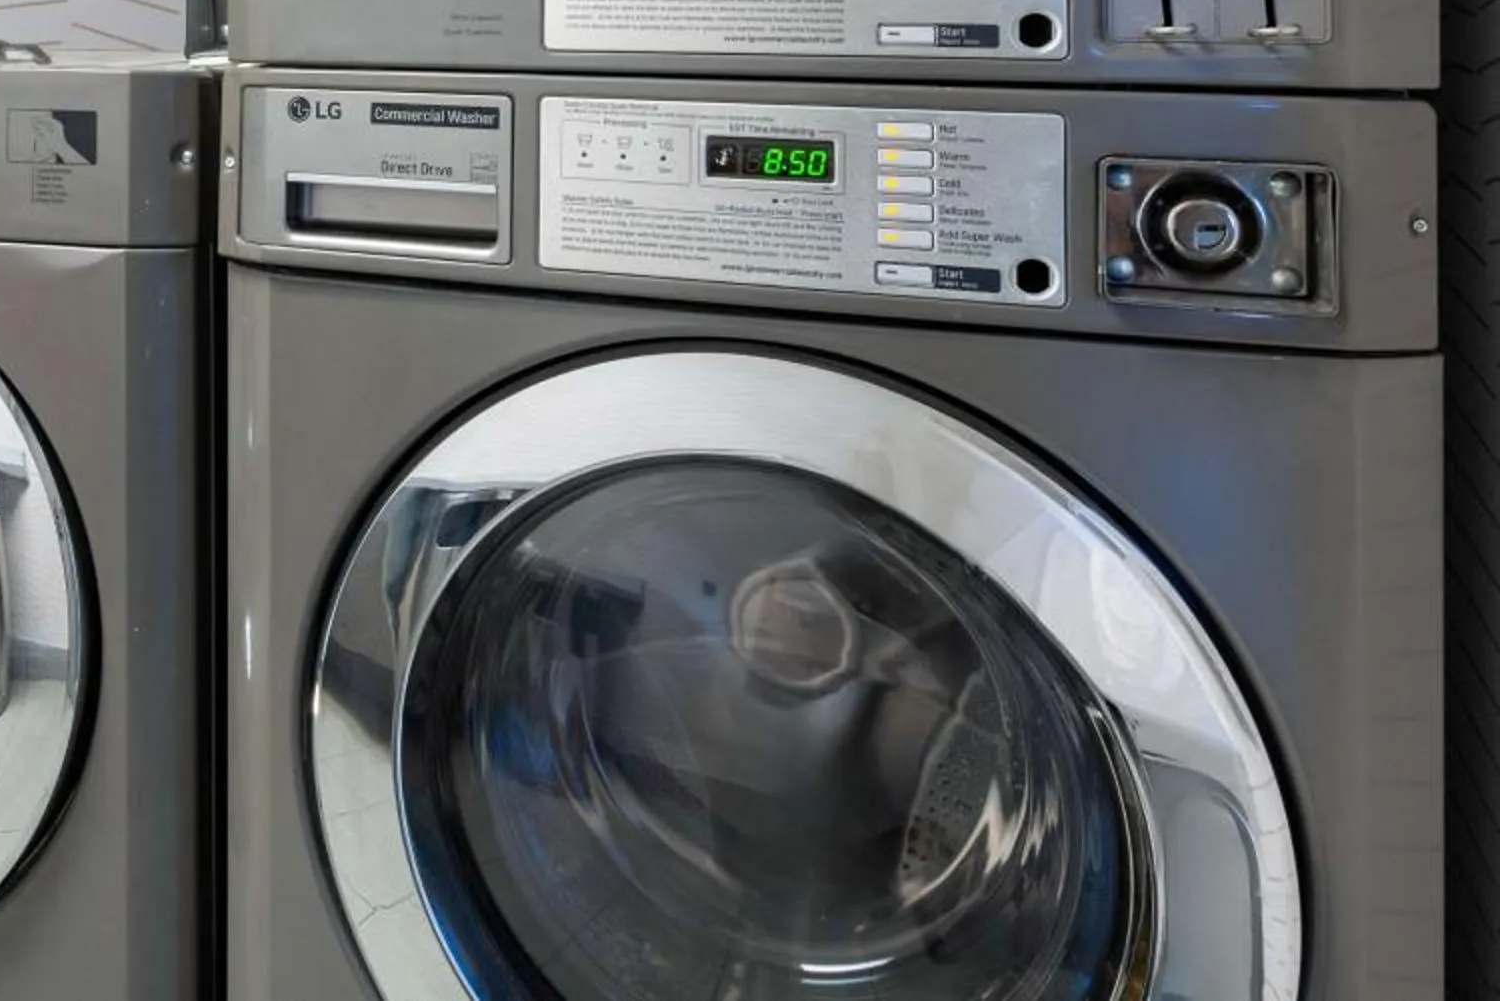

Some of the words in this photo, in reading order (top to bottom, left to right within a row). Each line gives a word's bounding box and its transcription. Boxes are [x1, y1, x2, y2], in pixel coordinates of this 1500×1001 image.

[940, 26, 966, 37] Start
[374, 106, 445, 123] Commercial
[447, 109, 497, 126] Washer
[381, 160, 418, 175] Direct
[420, 162, 453, 177] Drive
[939, 230, 959, 240] Add
[939, 267, 963, 279] Start
